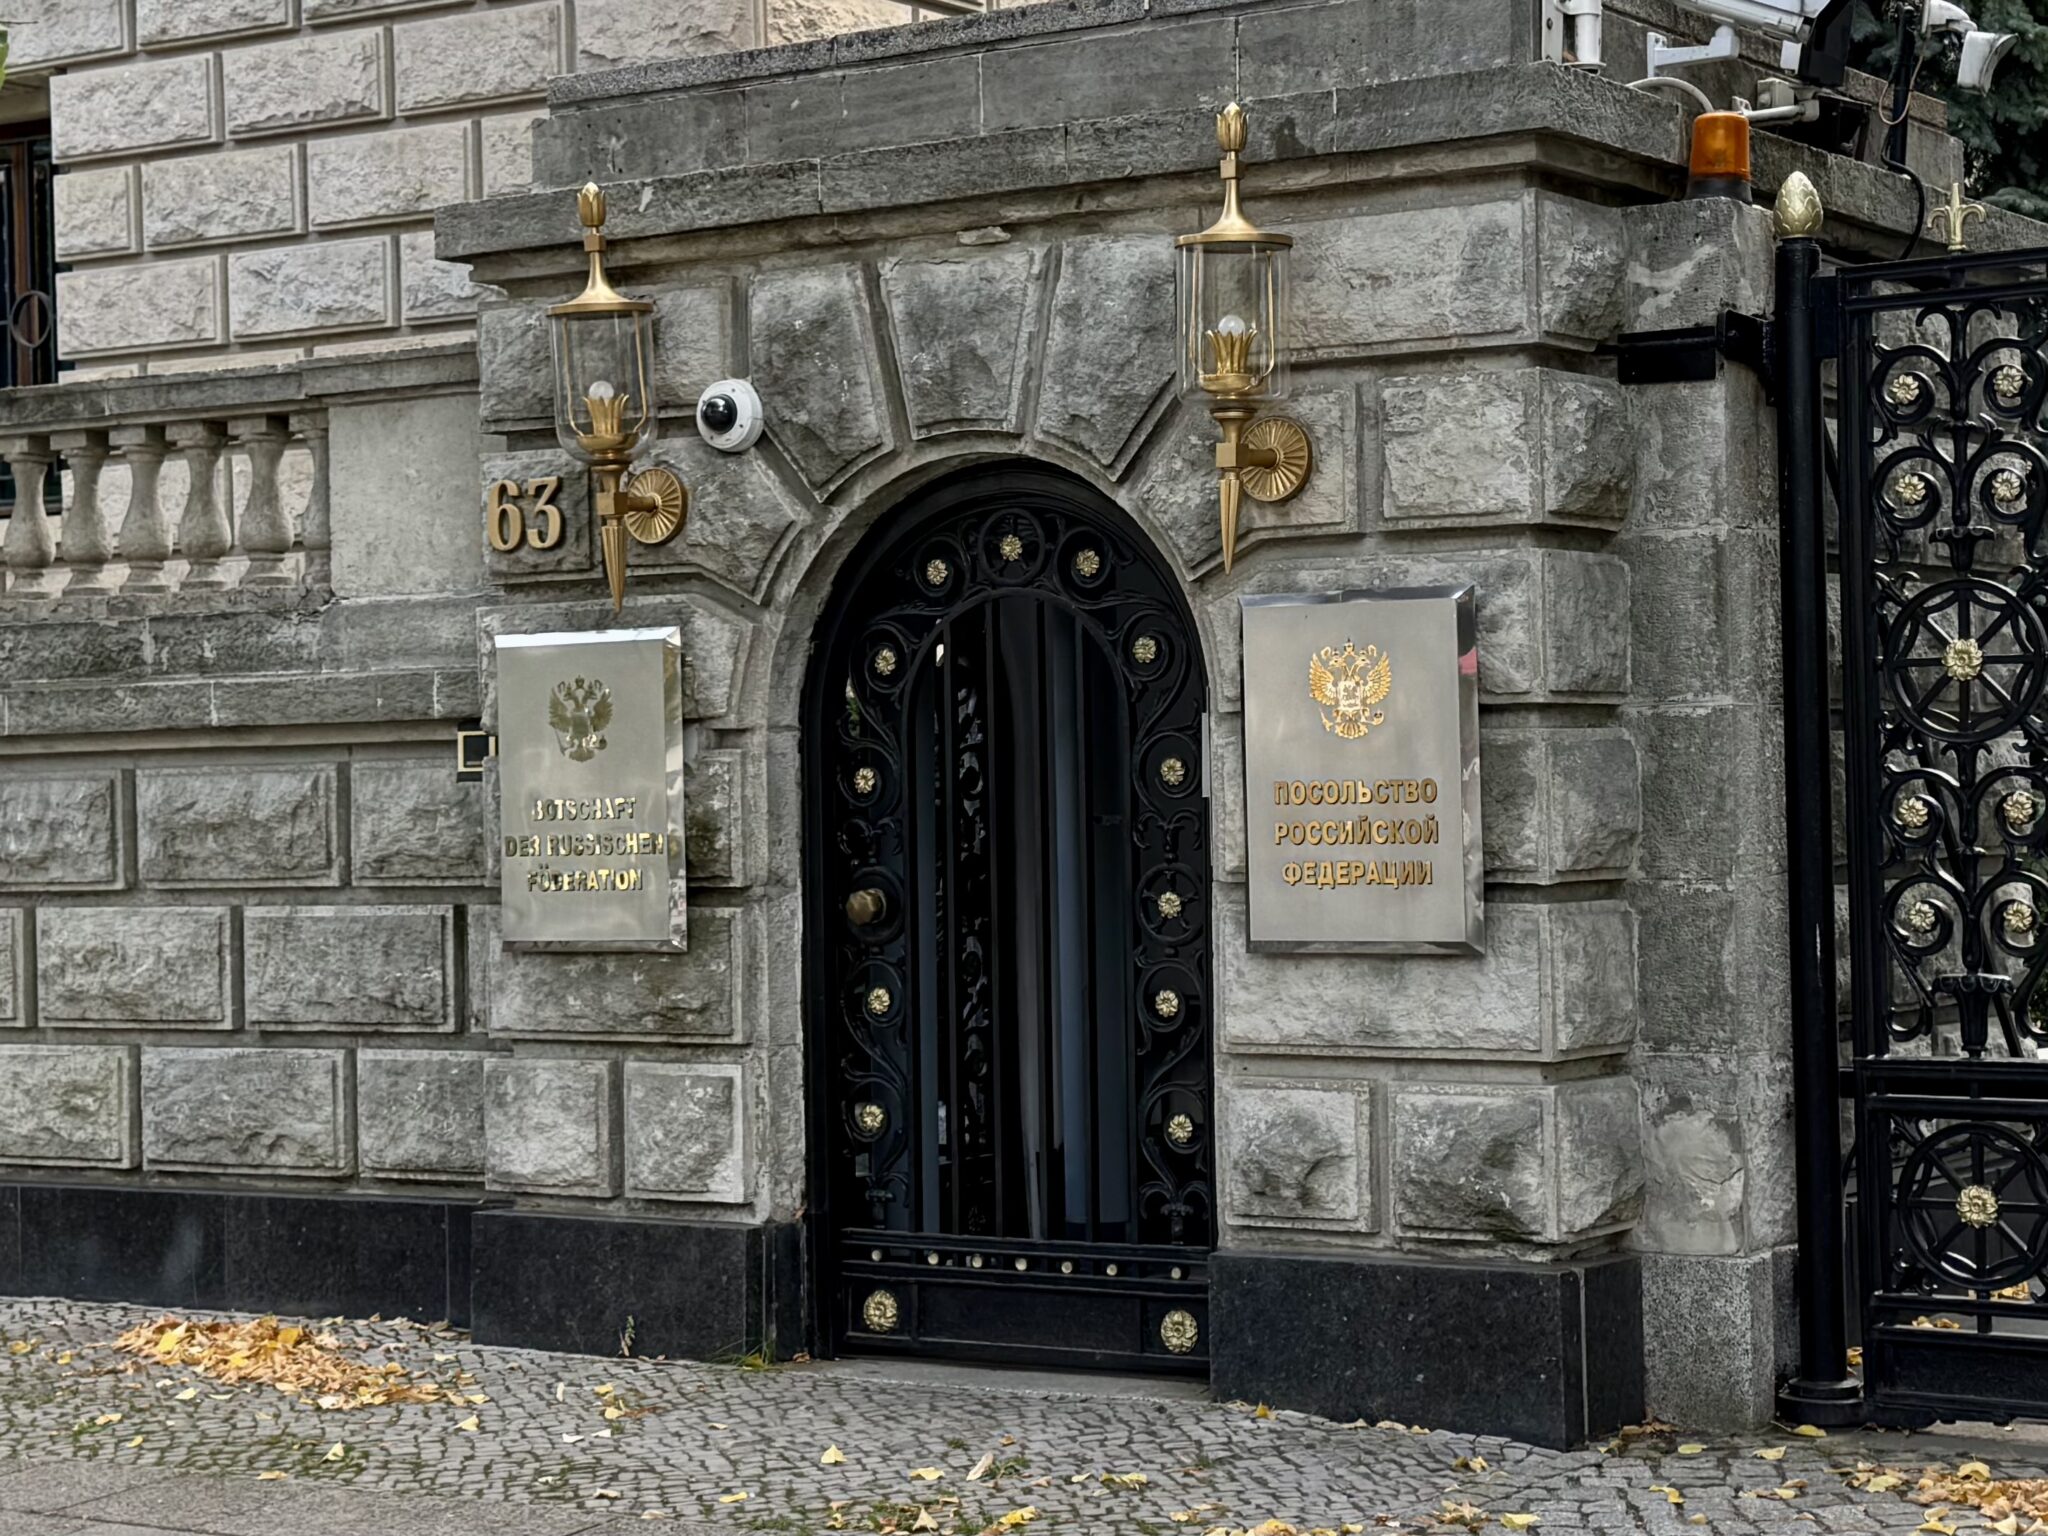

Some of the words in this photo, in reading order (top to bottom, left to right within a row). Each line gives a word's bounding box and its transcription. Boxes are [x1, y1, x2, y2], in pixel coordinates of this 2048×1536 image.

[487, 476, 562, 551] 63
[1273, 778, 1437, 805] ПОСОЛЬСТВО
[532, 797, 636, 821] BOTSCHAFT
[1274, 815, 1439, 845] РОССИЙСКОЙ
[504, 834, 541, 857] DER
[547, 832, 664, 856] RUSSISCHEN
[527, 864, 643, 892] FÖDERATION
[1281, 860, 1433, 889] ФЕДЕРАЦИИ
